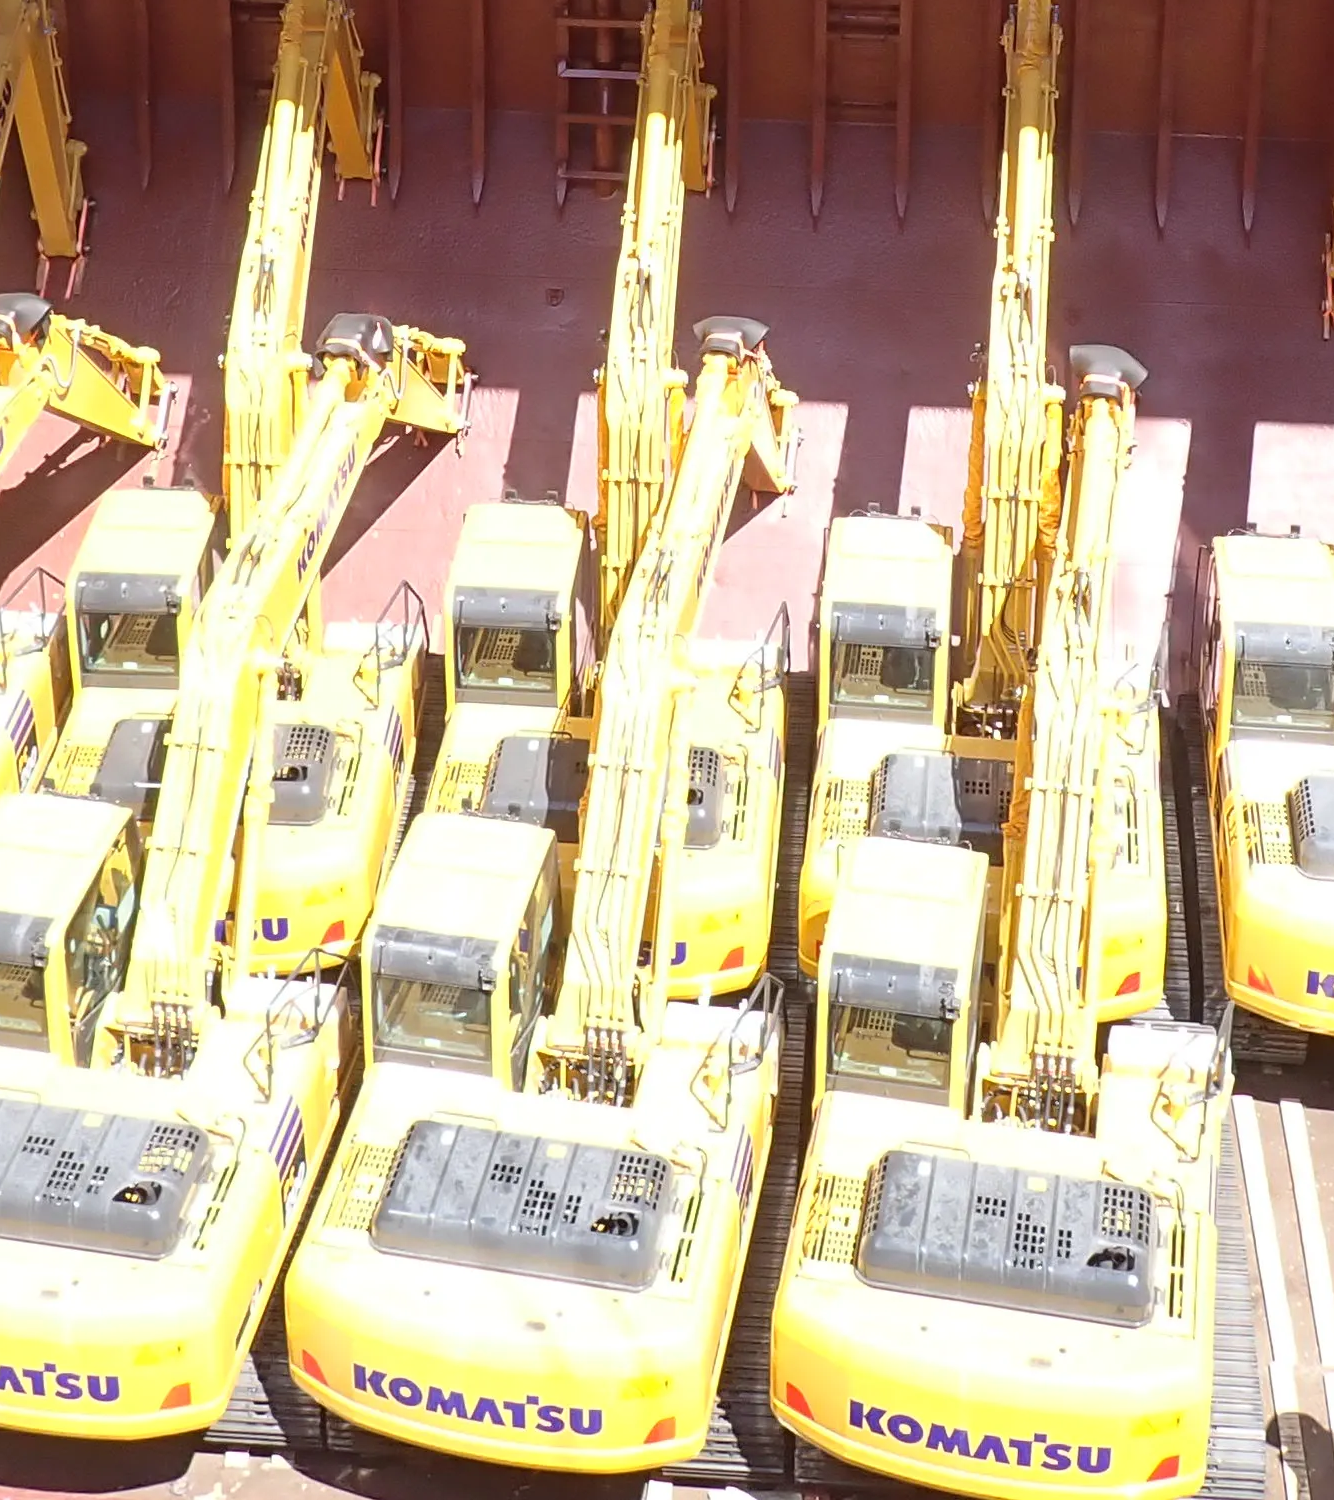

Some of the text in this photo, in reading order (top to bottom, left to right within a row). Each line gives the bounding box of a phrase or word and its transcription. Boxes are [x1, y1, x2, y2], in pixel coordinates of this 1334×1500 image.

[296, 445, 356, 581] KOMATSU
[353, 1363, 603, 1436] KOMATSU
[849, 1398, 1112, 1474] KOMATSU
